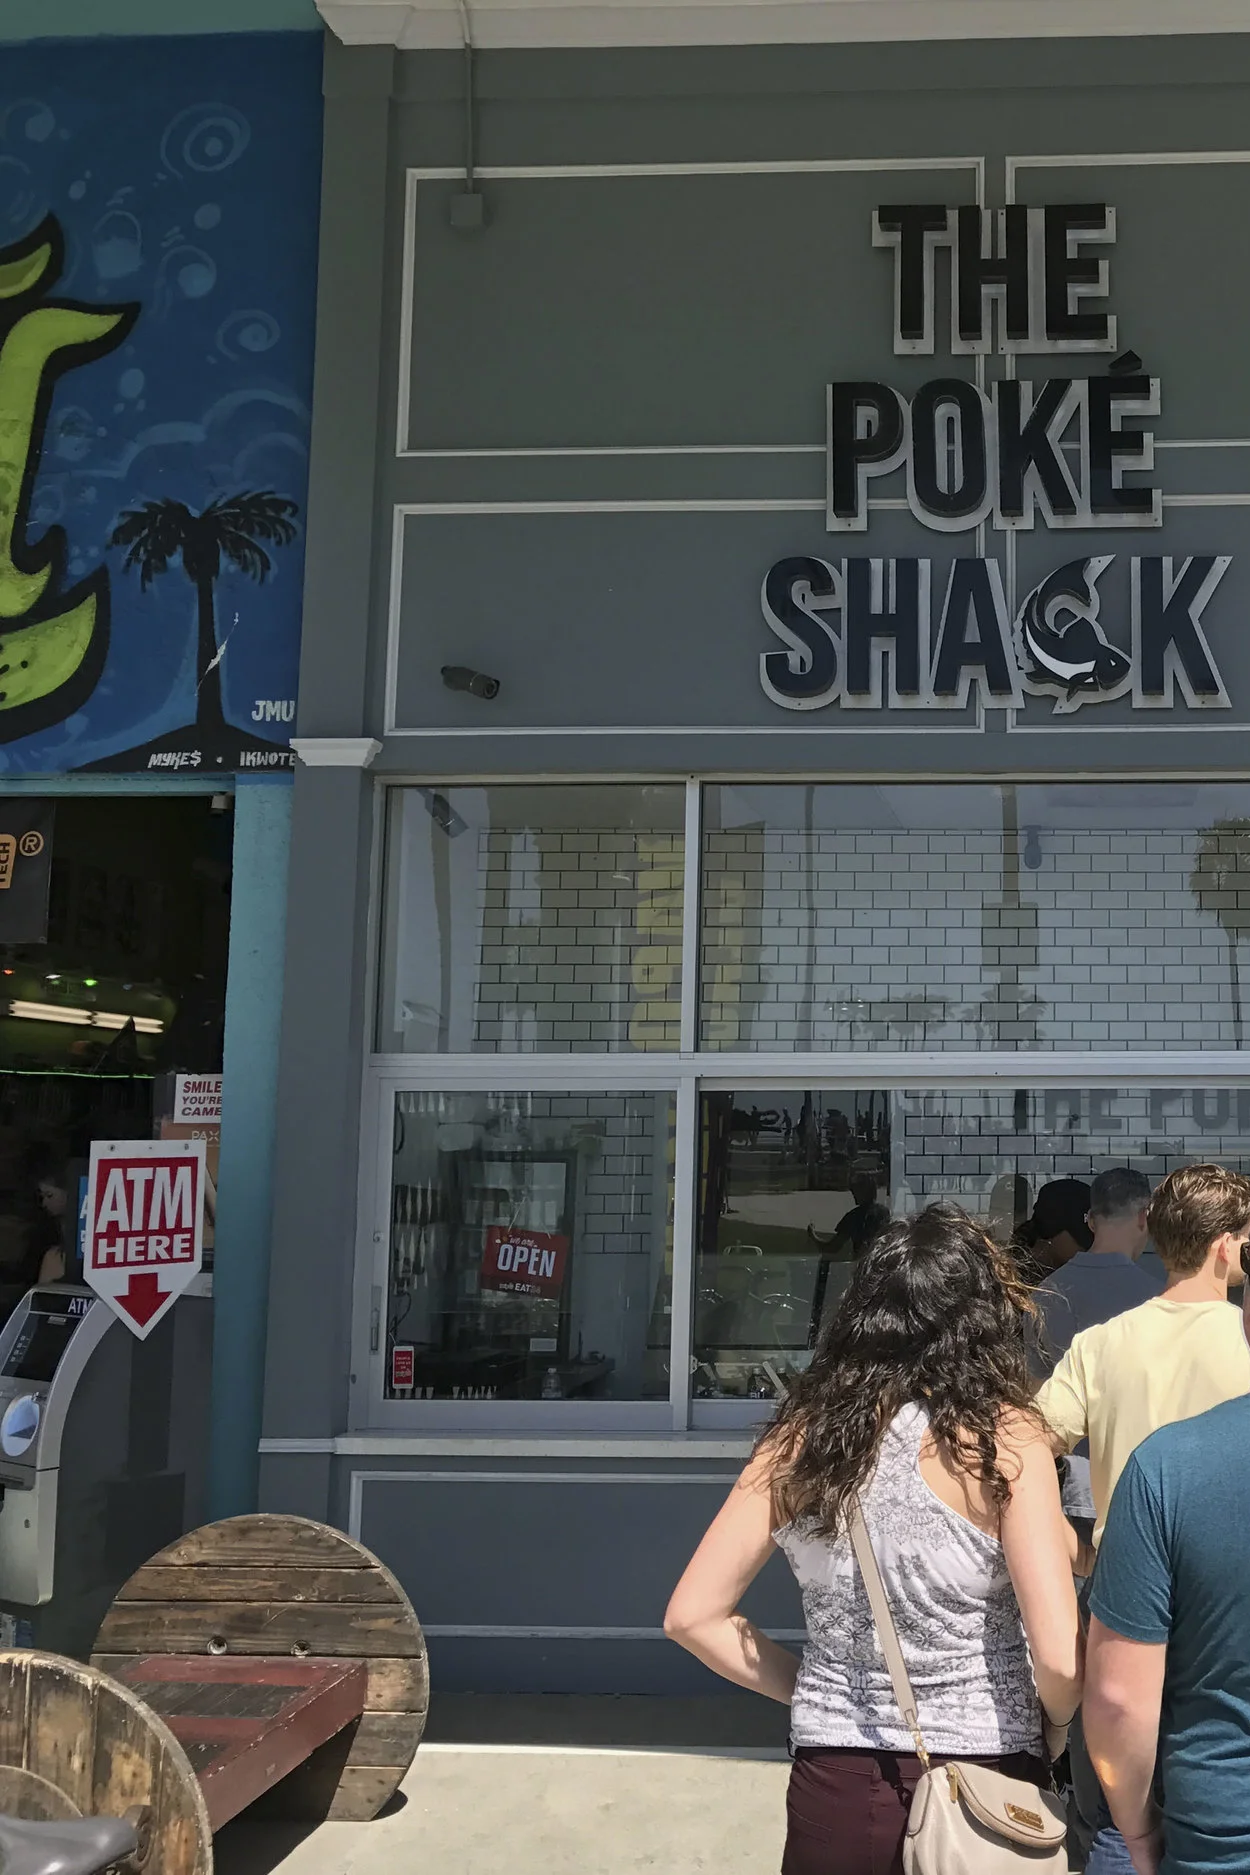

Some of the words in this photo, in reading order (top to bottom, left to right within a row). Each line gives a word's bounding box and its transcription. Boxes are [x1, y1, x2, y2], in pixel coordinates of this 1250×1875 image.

[872, 204, 1117, 354] THE
[826, 350, 1162, 532] POKÉ
[251, 700, 295, 722] JMU
[183, 1081, 222, 1093] SMILE
[95, 1166, 192, 1233] ATM
[97, 1234, 191, 1264] HERE
[498, 1244, 556, 1277] OPEN
